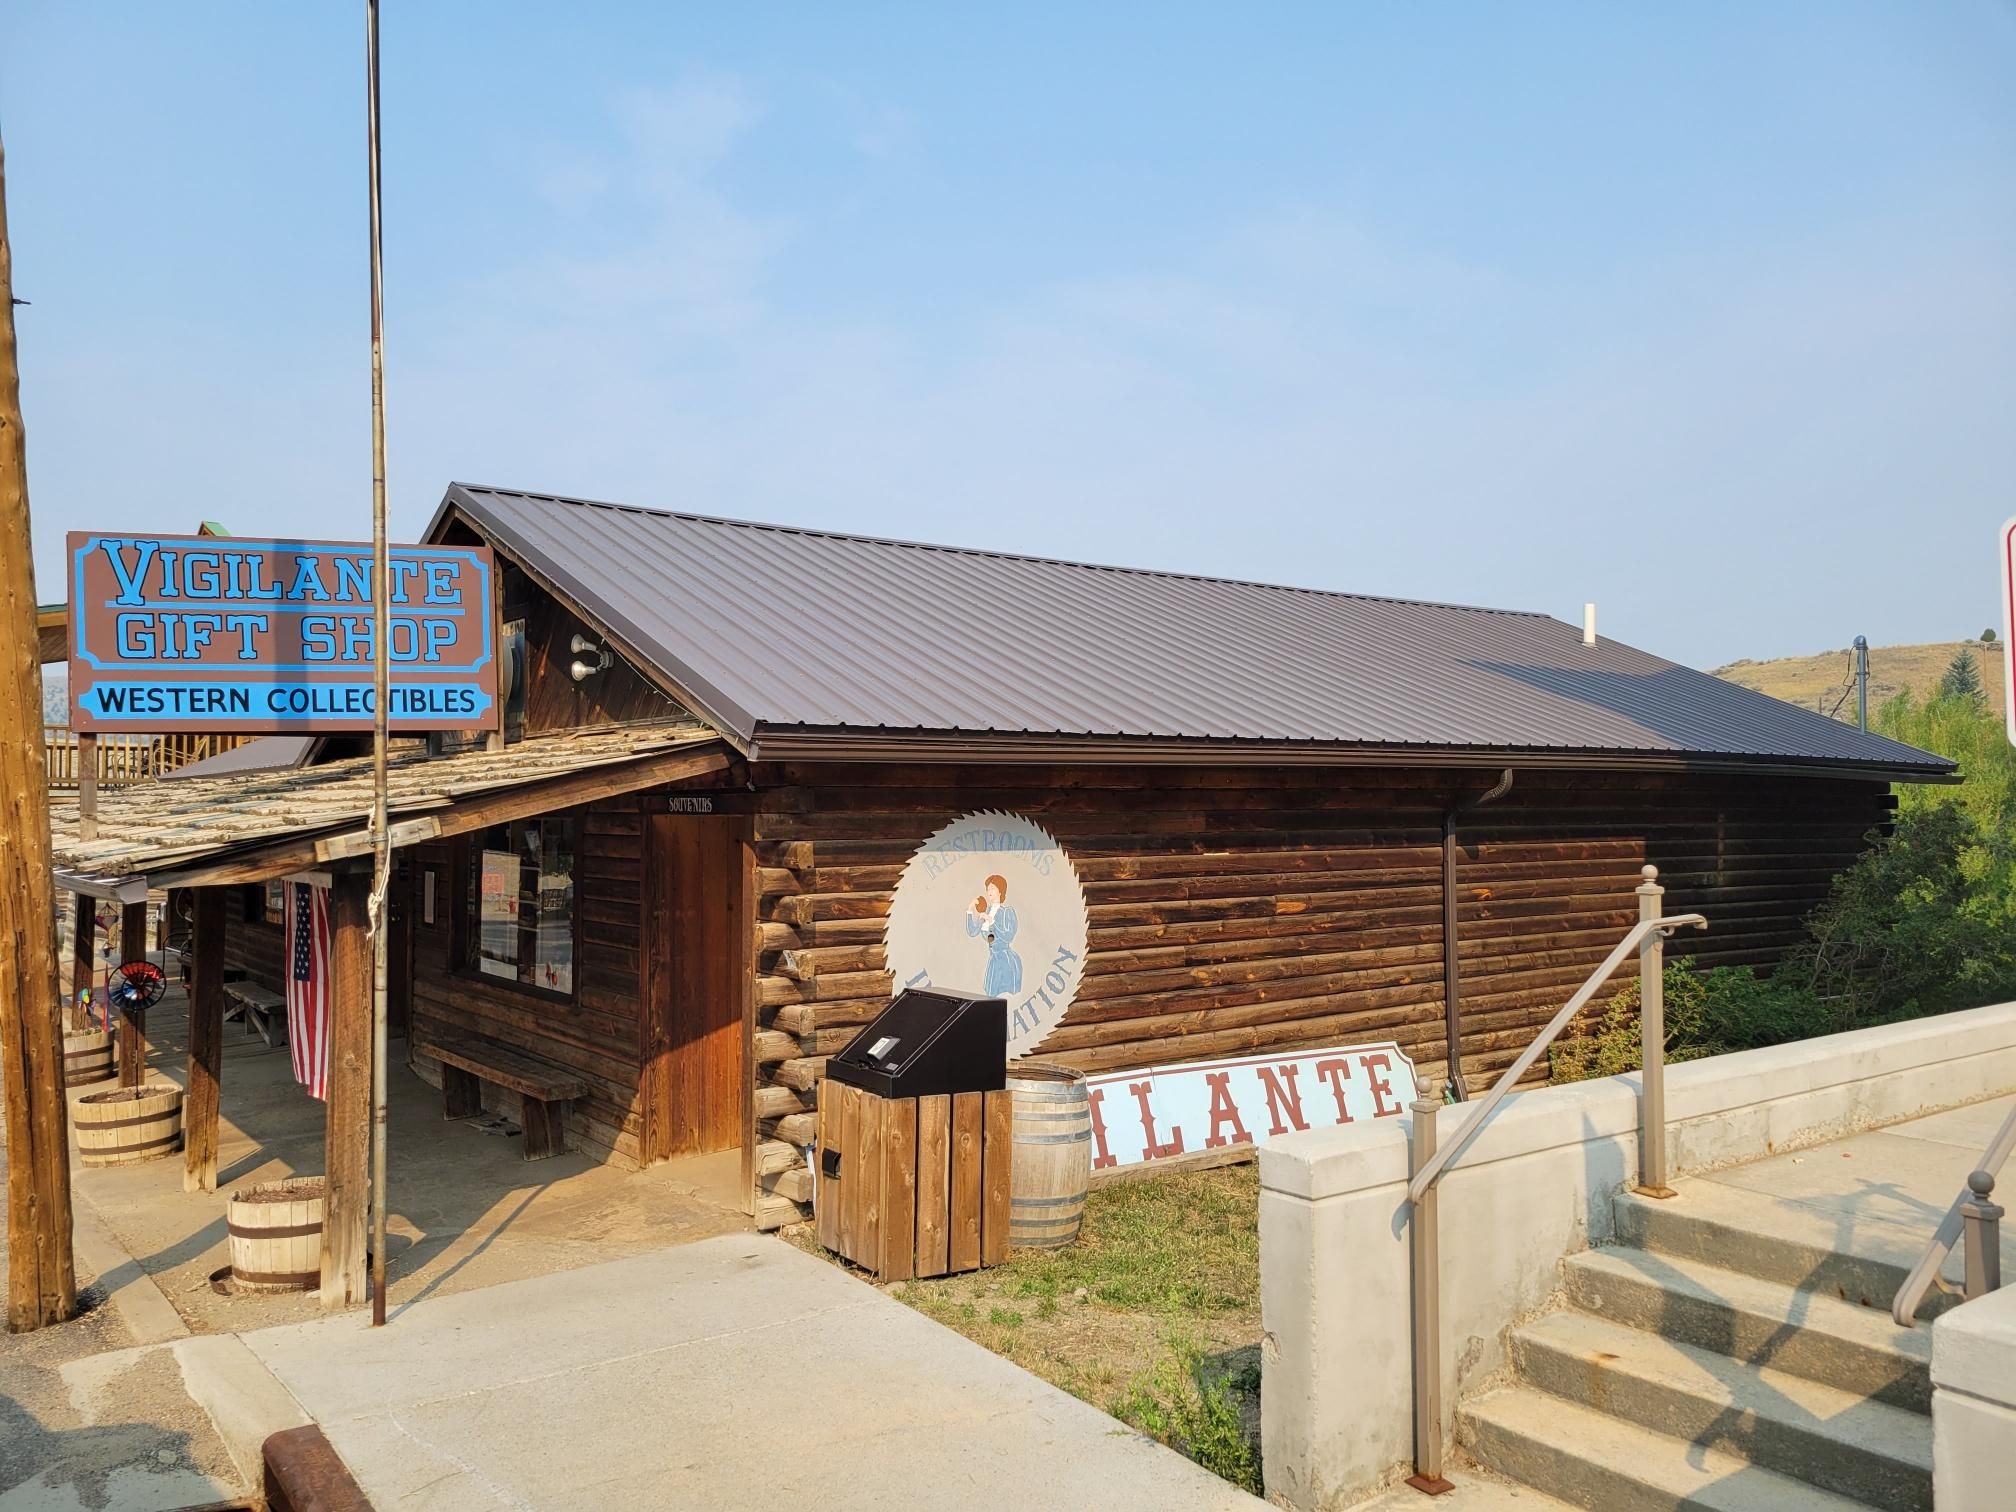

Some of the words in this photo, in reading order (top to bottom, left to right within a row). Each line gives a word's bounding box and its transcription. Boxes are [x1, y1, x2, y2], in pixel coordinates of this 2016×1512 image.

[100, 540, 462, 604] VIGILANTE
[116, 612, 268, 660] GIFT
[301, 616, 457, 662] SHOP
[97, 687, 249, 713] WESTERN
[267, 688, 475, 713] COLLECTIBLES
[669, 797, 712, 812] SOUVENIRS
[921, 828, 1054, 880] RESTROOMS
[1088, 1053, 1403, 1170] ILANTE
